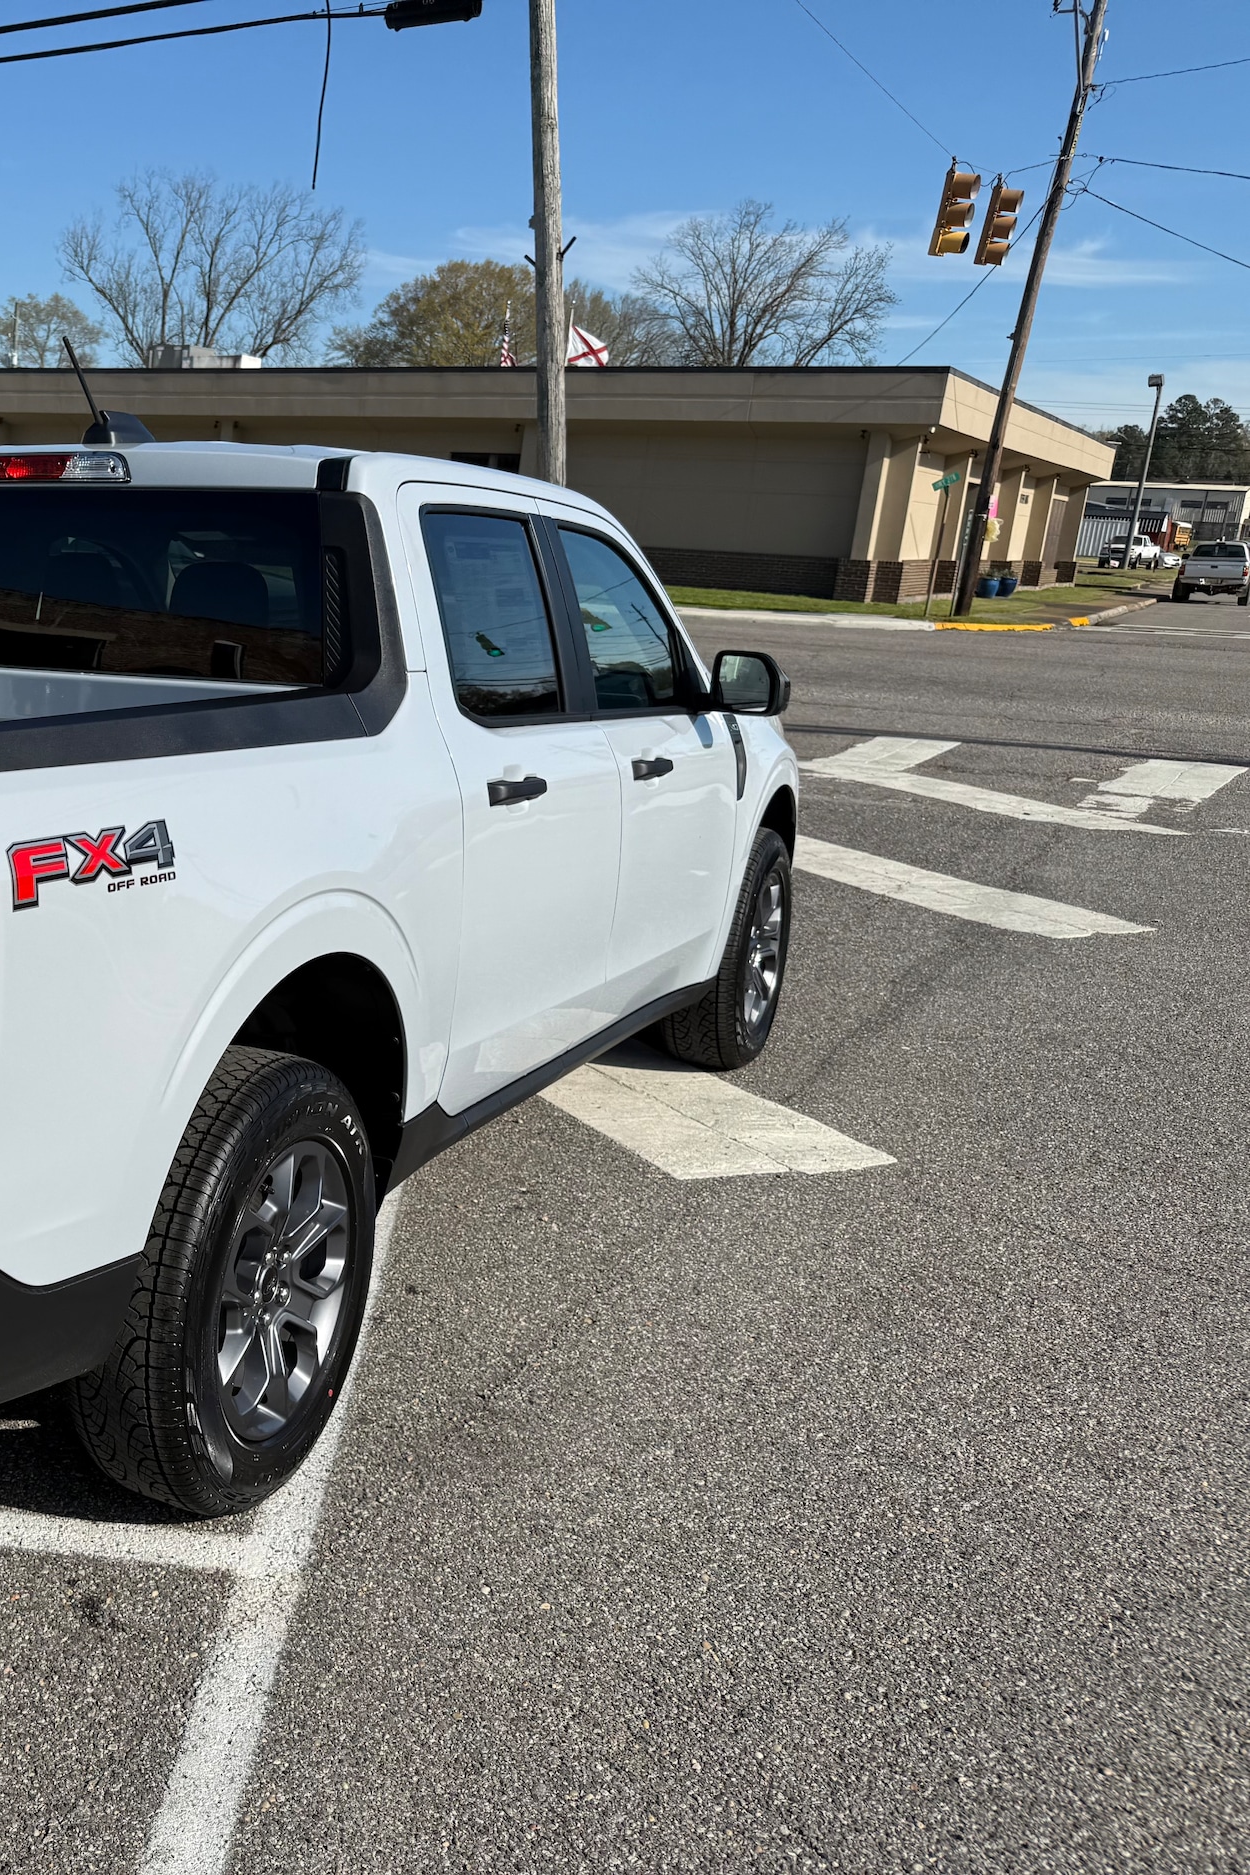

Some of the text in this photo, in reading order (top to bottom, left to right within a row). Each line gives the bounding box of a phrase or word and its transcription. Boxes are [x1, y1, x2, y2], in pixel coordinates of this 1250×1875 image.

[5, 817, 176, 913] FX4
[107, 871, 176, 893] OFF ROAD
